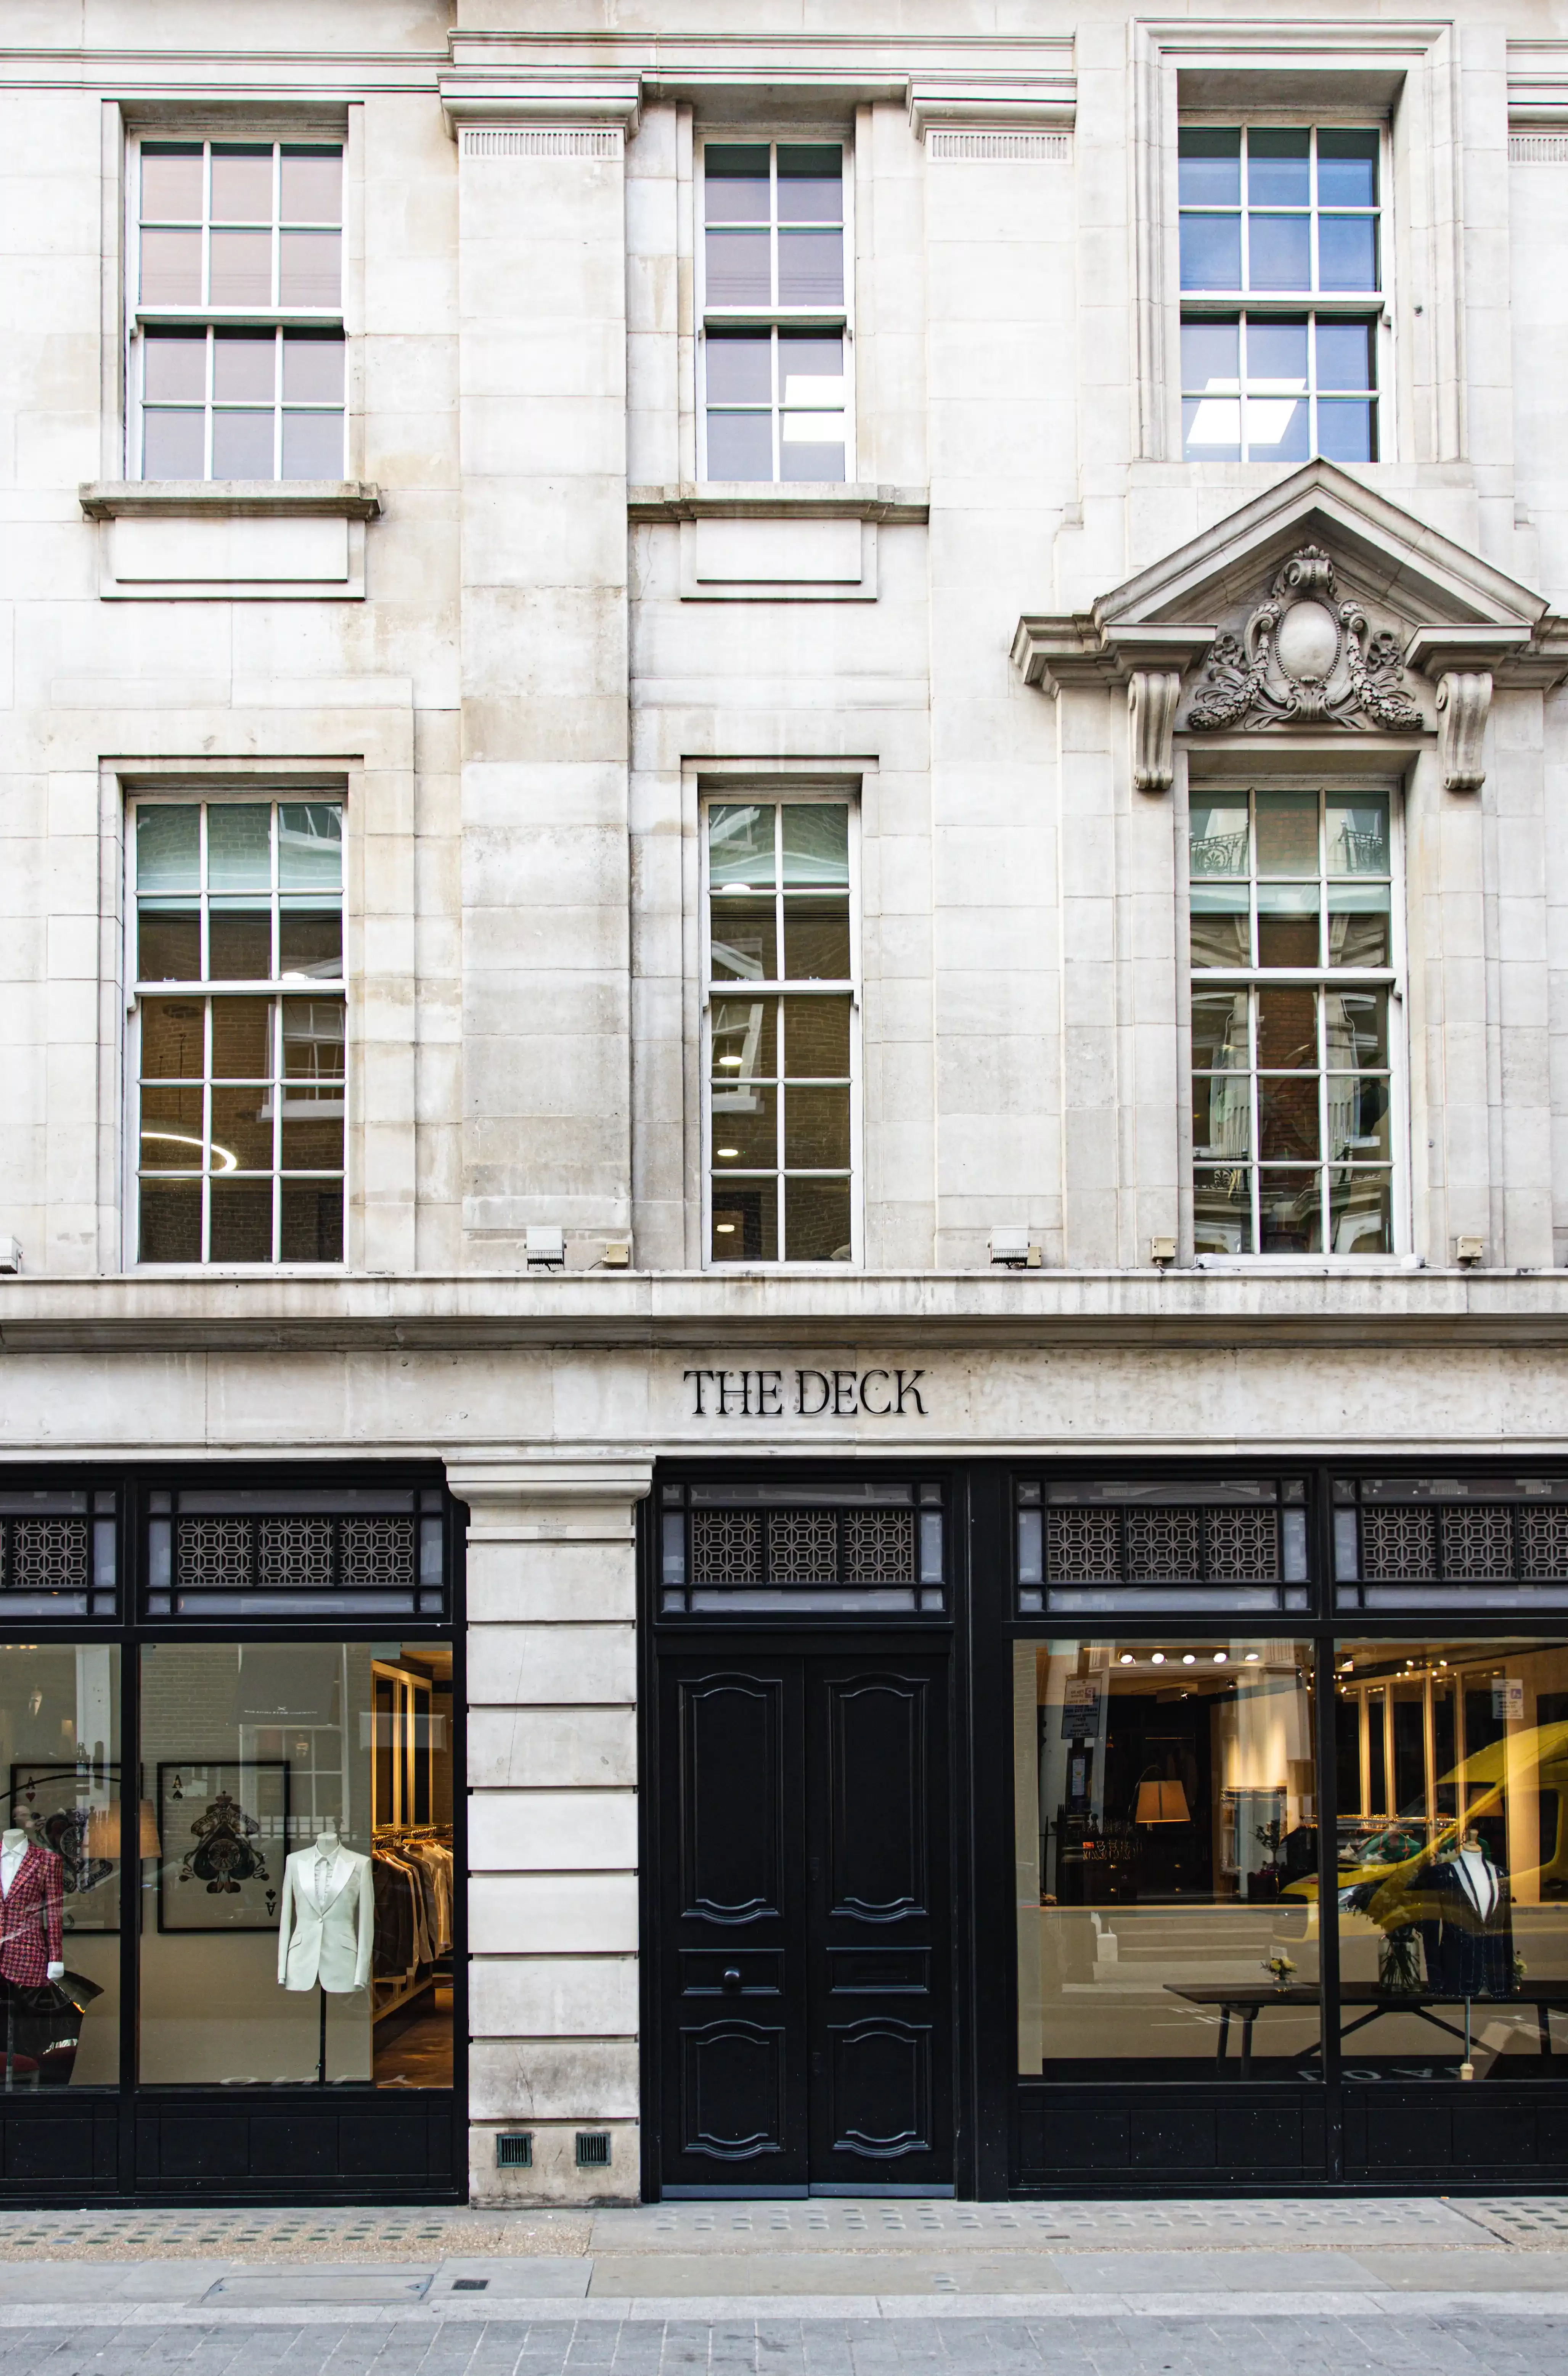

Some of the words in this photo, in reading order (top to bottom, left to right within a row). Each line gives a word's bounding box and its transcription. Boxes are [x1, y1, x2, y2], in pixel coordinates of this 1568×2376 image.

[684, 1371, 782, 1415] THE
[795, 1370, 929, 1415] DECK
[172, 1774, 183, 1788] A
[265, 1902, 277, 1916] A
